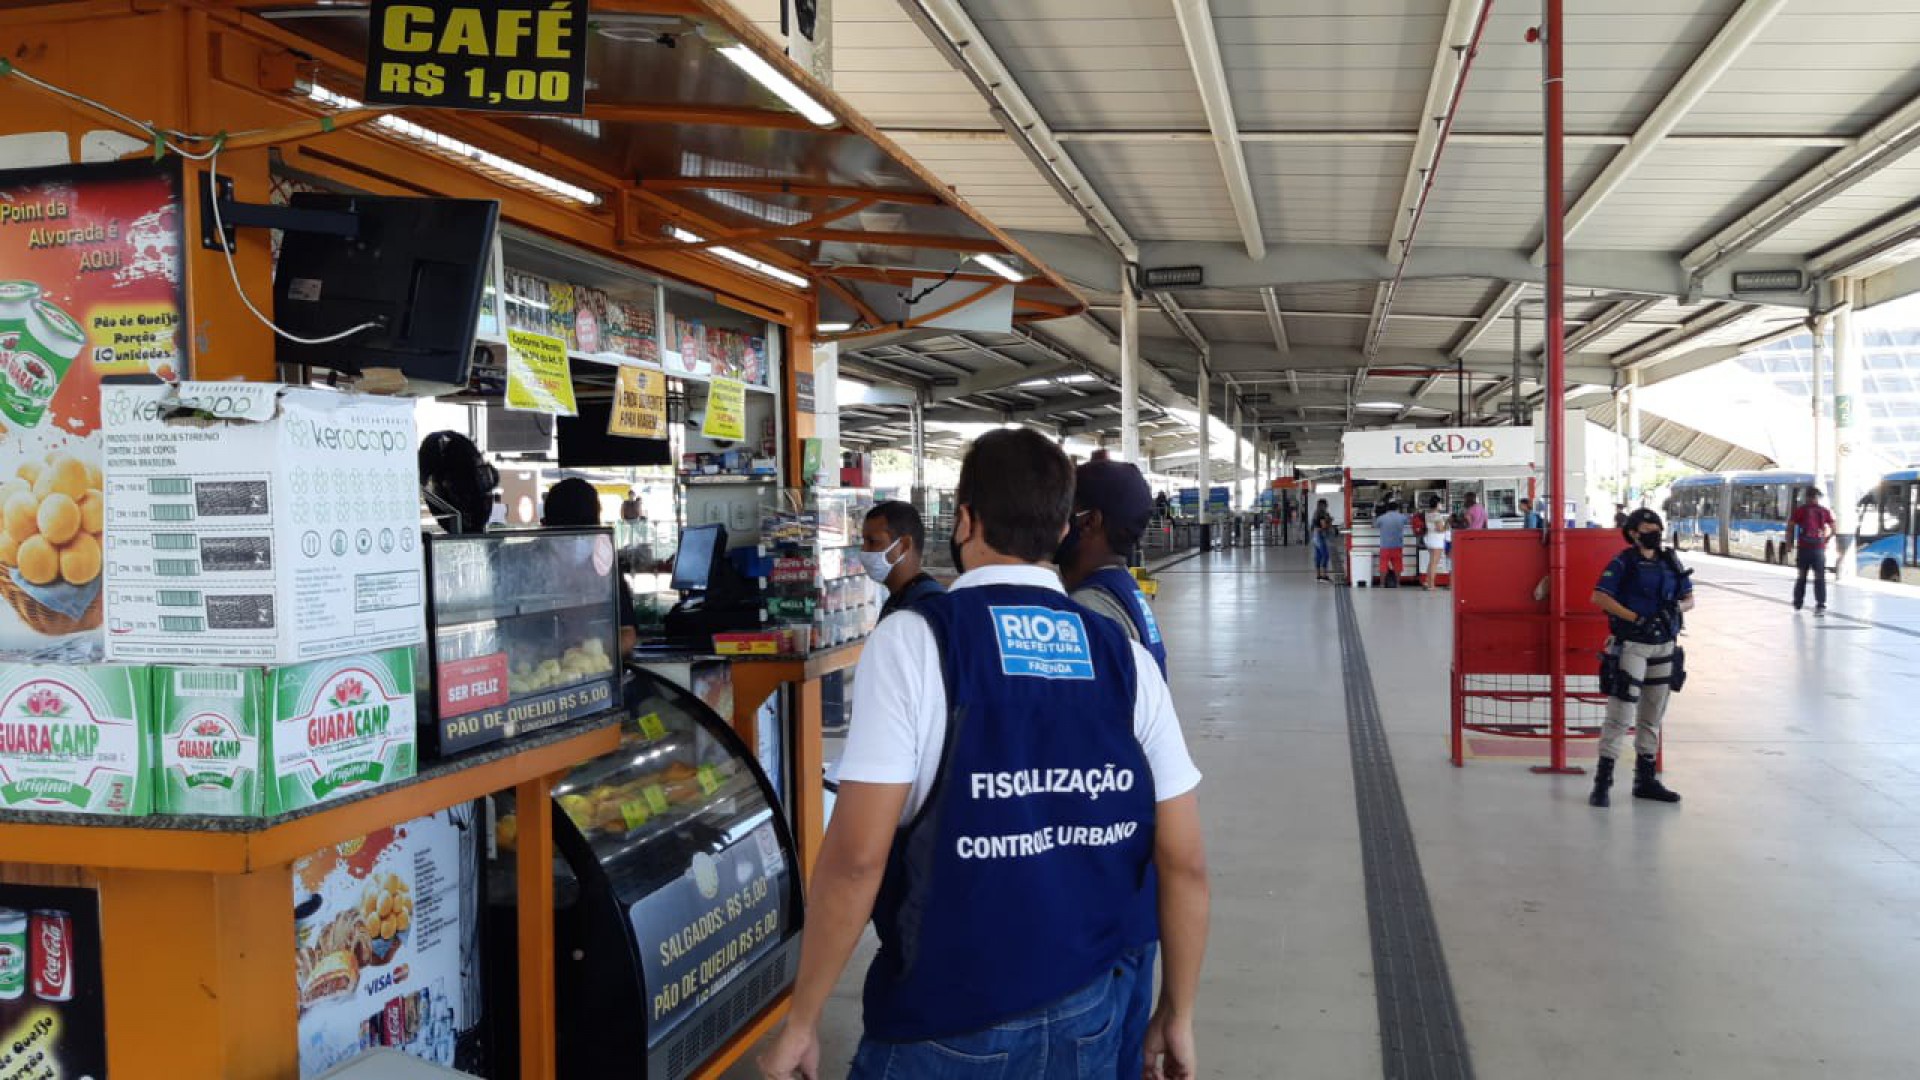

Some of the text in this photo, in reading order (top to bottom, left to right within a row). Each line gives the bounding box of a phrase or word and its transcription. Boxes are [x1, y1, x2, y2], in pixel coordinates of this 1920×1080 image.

[383, 1, 573, 59] CAFÉ
[379, 62, 570, 104] R$ 1,00
[1, 201, 67, 222] Point da
[28, 221, 104, 248] Alvorada
[94, 315, 116, 330] Pão
[119, 314, 133, 327] de
[137, 312, 178, 328] Queijo
[114, 331, 156, 346] Porção
[1394, 434, 1494, 459] Ice&Dog
[1001, 614, 1056, 643] RIO
[1007, 638, 1083, 654] PREFEITURA
[1028, 660, 1073, 673] FAZENDA
[448, 677, 499, 702] SER FELIZ
[308, 704, 390, 747] GUARACAMP
[446, 717, 480, 740] PÃO
[483, 712, 504, 730] DE
[507, 698, 556, 723] QUEIJO
[559, 693, 577, 711] R$
[177, 740, 241, 759] GUARACAMP
[971, 762, 1135, 800] FISCALIZAÇÃO
[957, 821, 1138, 859] CONTROLE URBANO
[726, 892, 742, 922] R$
[743, 876, 768, 909] 5,00
[654, 983, 679, 1021] PÃO
[682, 969, 698, 999] DE
[701, 939, 737, 986] QUEIJO
[739, 927, 754, 954] R$
[755, 909, 778, 943] 5,00
[366, 972, 392, 997] VISA
[13, 1016, 52, 1054] Queijo
